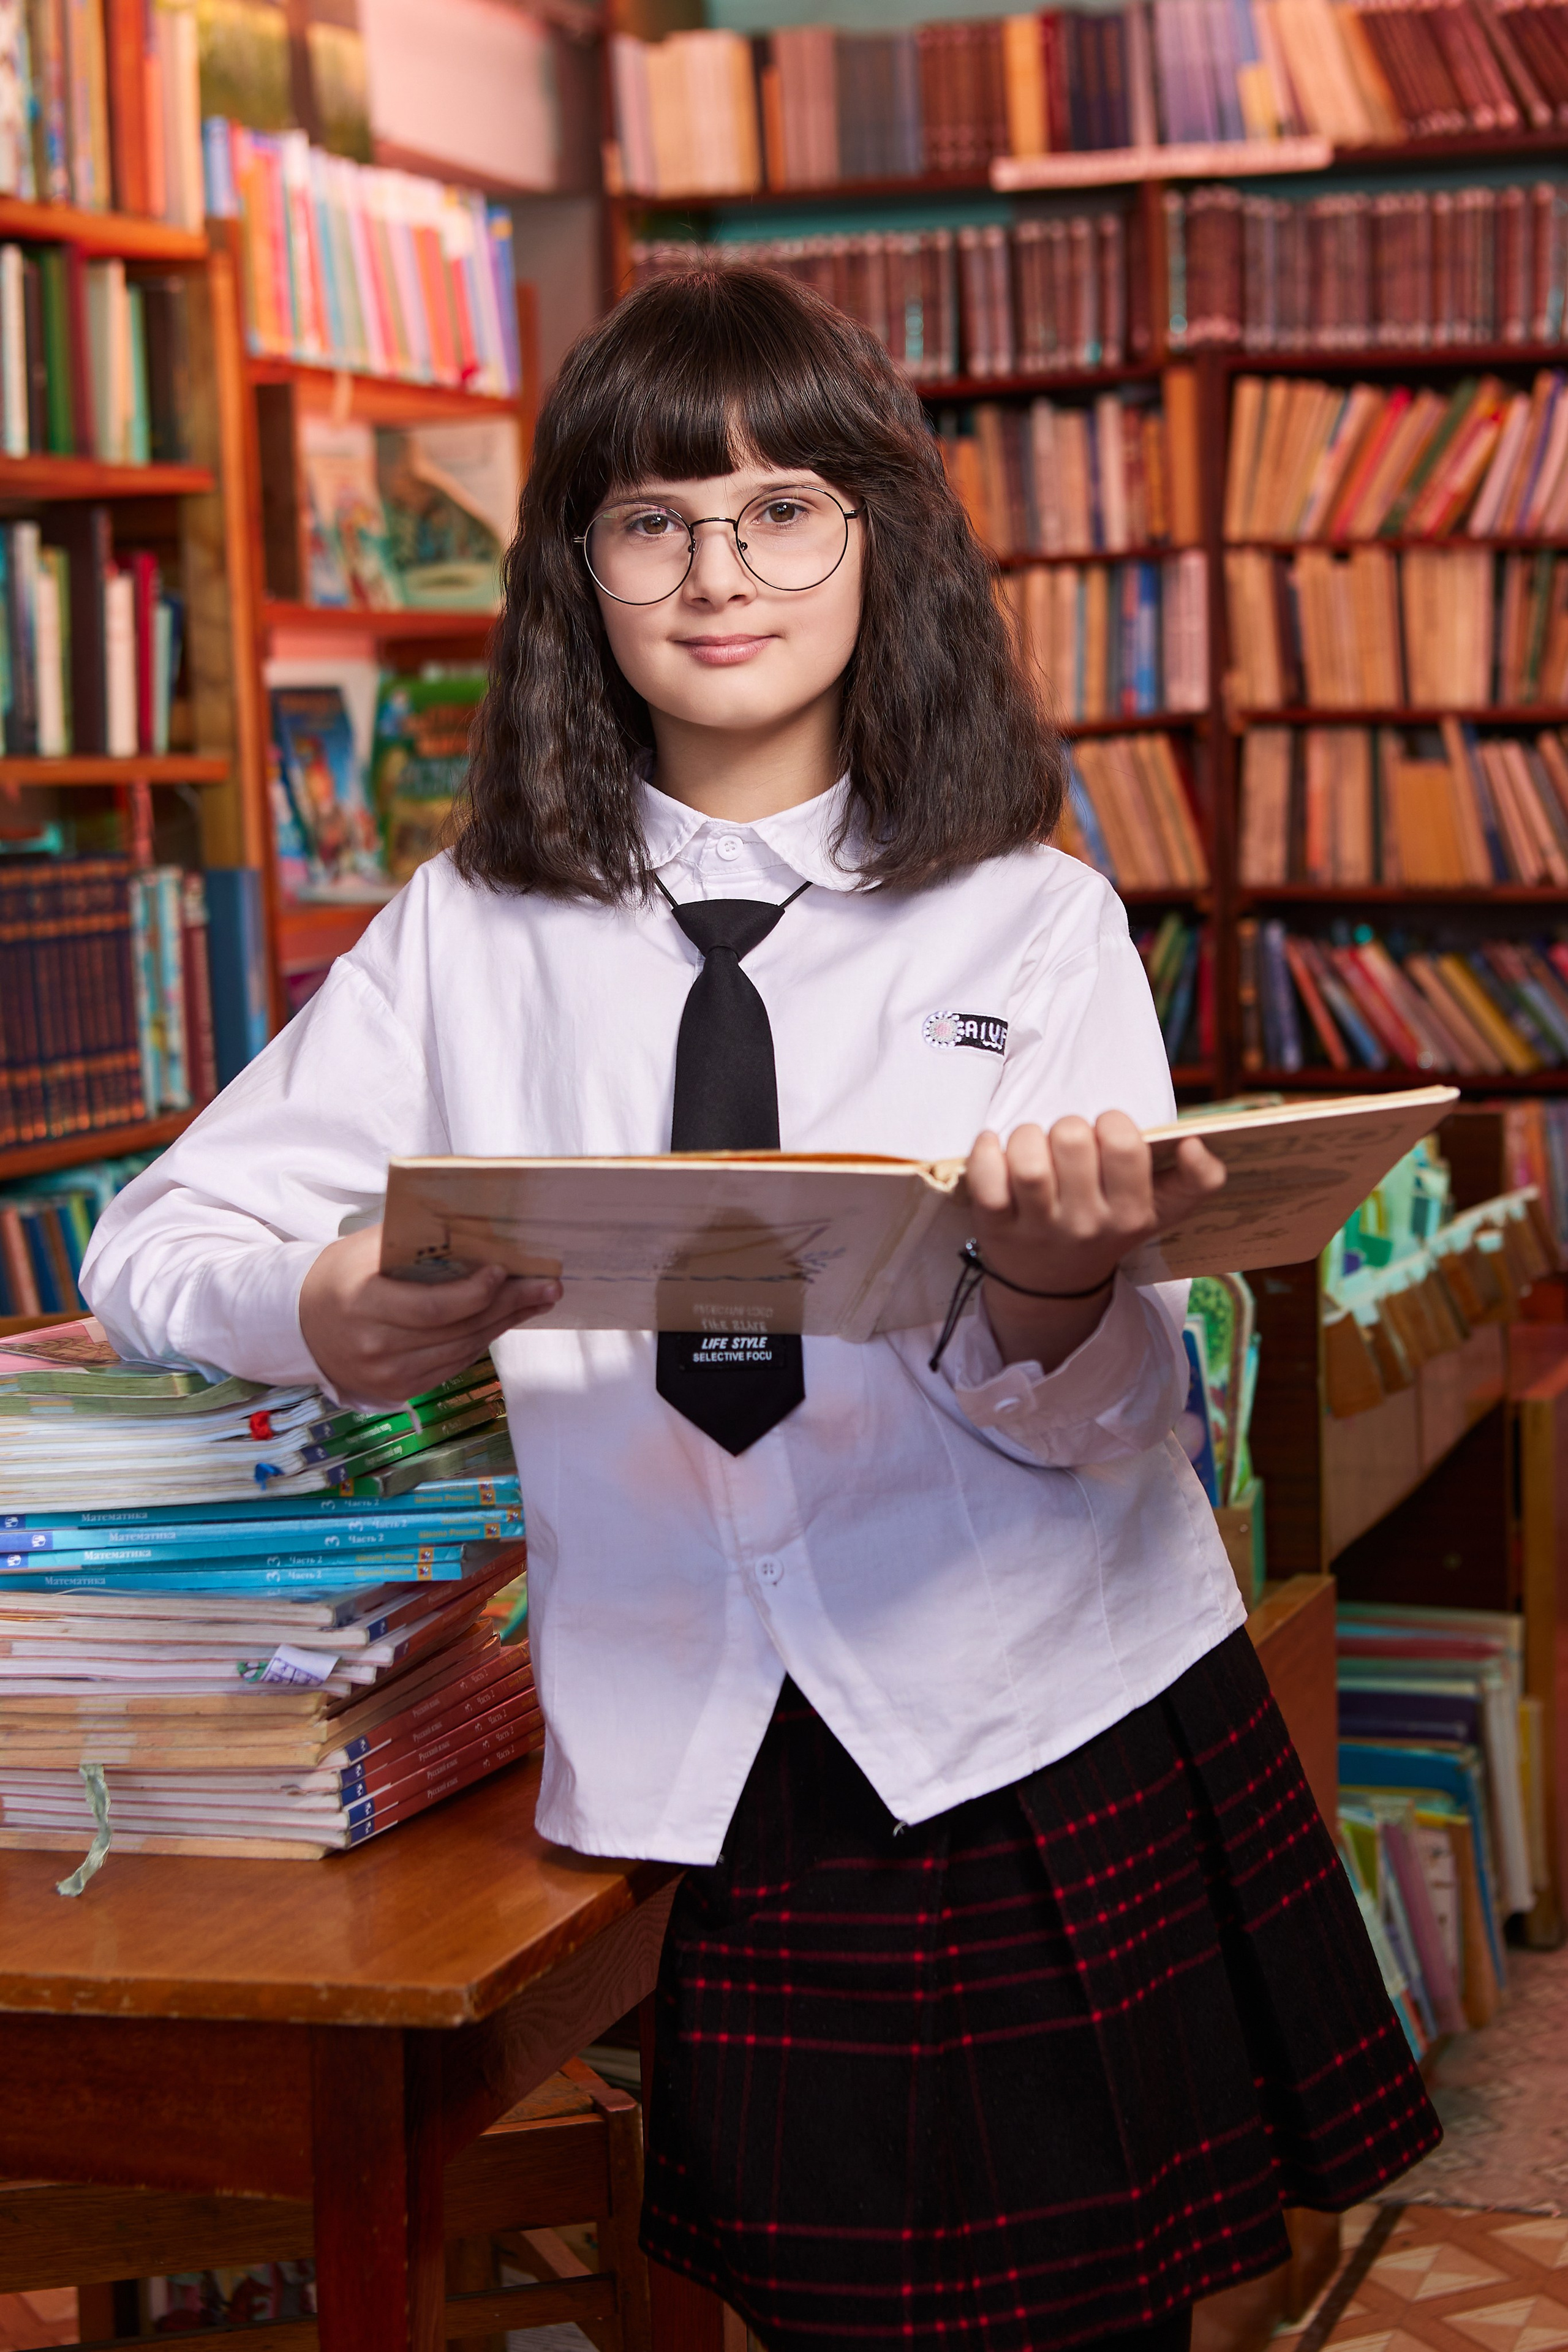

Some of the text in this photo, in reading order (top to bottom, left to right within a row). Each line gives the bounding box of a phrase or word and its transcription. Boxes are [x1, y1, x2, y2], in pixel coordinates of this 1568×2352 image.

[701, 1336, 767, 1349] LIFE STYLE
[693, 1351, 772, 1362] SELECTIVE FOCU
[81, 1512, 148, 1522] Математика
[109, 1532, 176, 1542] Математика
[372, 1520, 398, 1529] Часть
[84, 1550, 151, 1561] Математика
[349, 1535, 376, 1544] Часть
[378, 1533, 384, 1542] 2
[45, 1577, 105, 1585] Математика
[288, 1571, 314, 1580] Часть
